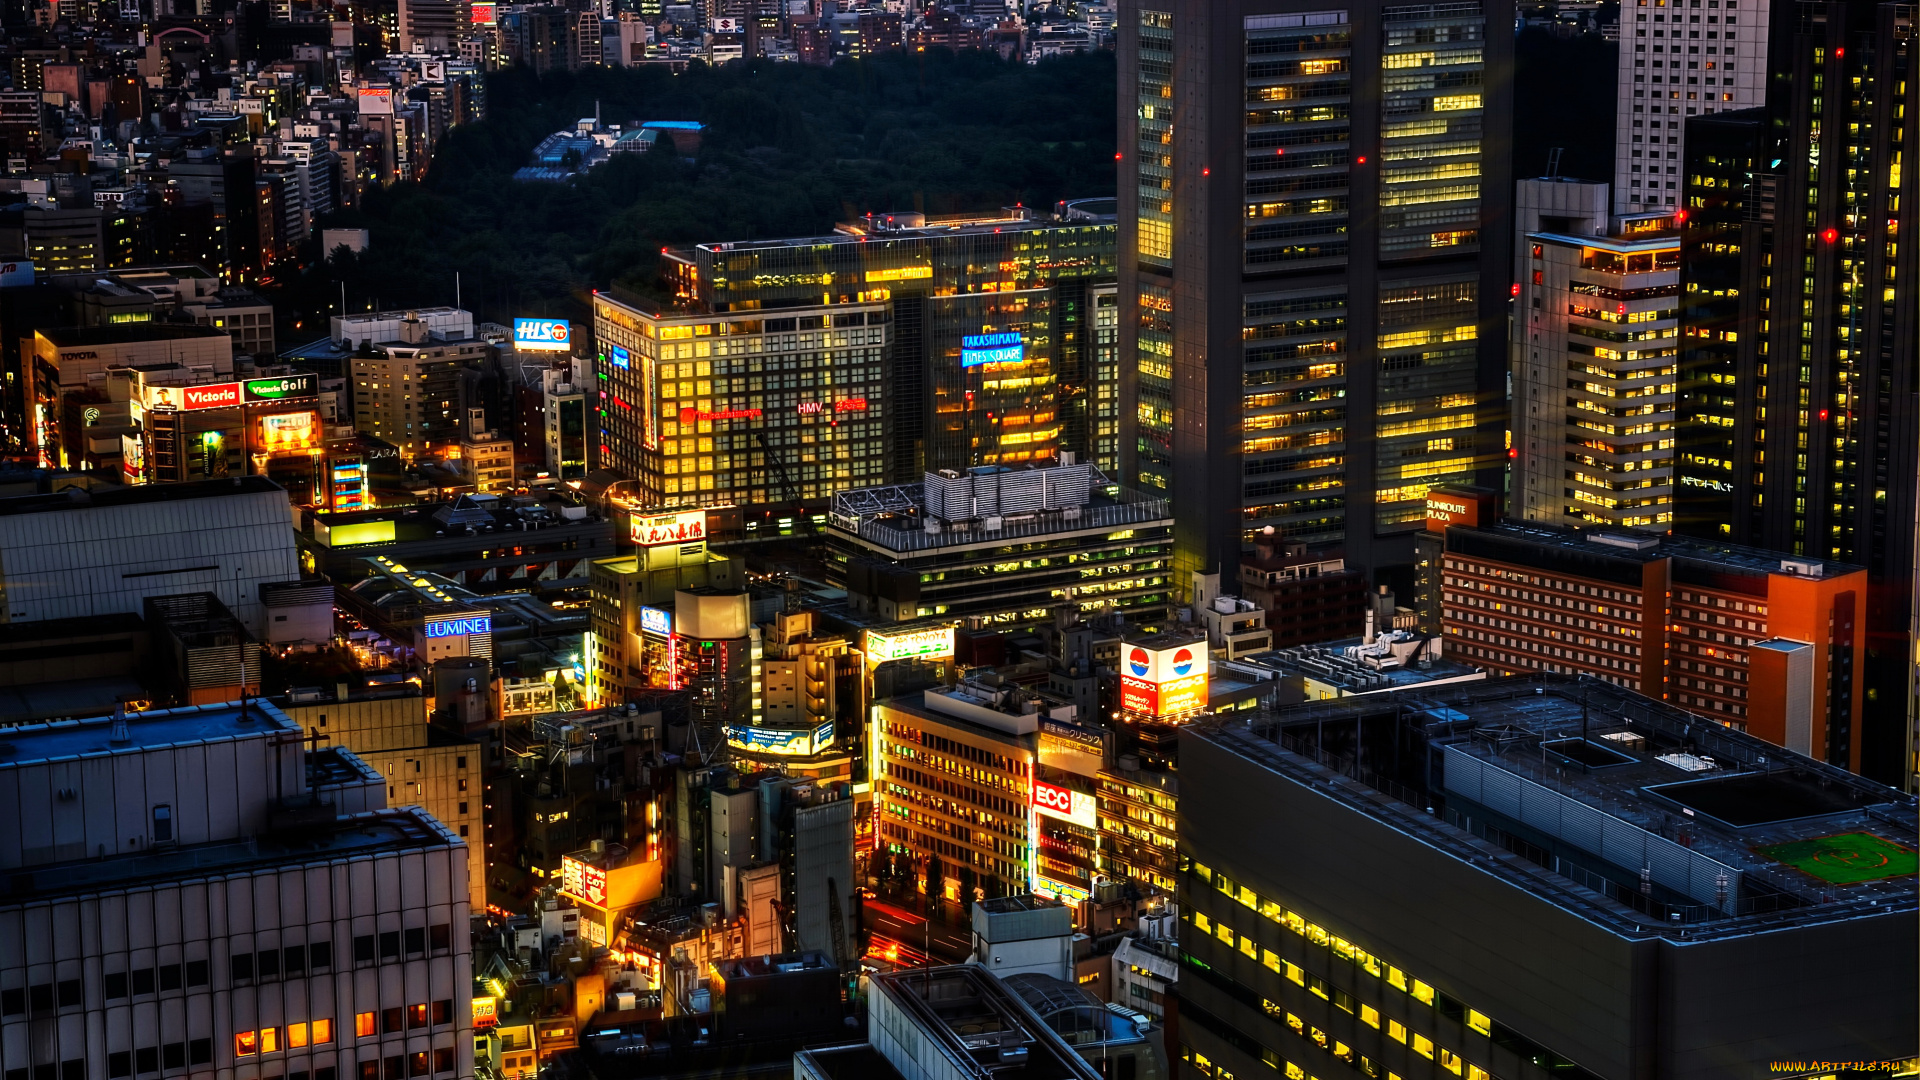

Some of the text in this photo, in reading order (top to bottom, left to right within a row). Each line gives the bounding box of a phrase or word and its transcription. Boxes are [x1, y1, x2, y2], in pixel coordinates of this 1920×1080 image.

[0, 263, 17, 274] JTB
[963, 332, 1021, 348] TAKASHIMAYA
[61, 351, 97, 361] TOYOTA
[965, 348, 1020, 367] TIMES SQUARE
[252, 378, 308, 395] Victoria Golf
[187, 389, 236, 404] Victoria
[695, 407, 762, 422] Takashimaya
[369, 448, 398, 460] ZARA
[1427, 499, 1466, 515] SUNROUTE
[1427, 509, 1451, 522] PLAZA
[911, 631, 947, 645] TOYOTA
[1036, 785, 1069, 810] ECC
[564, 858, 584, 898] 薬
